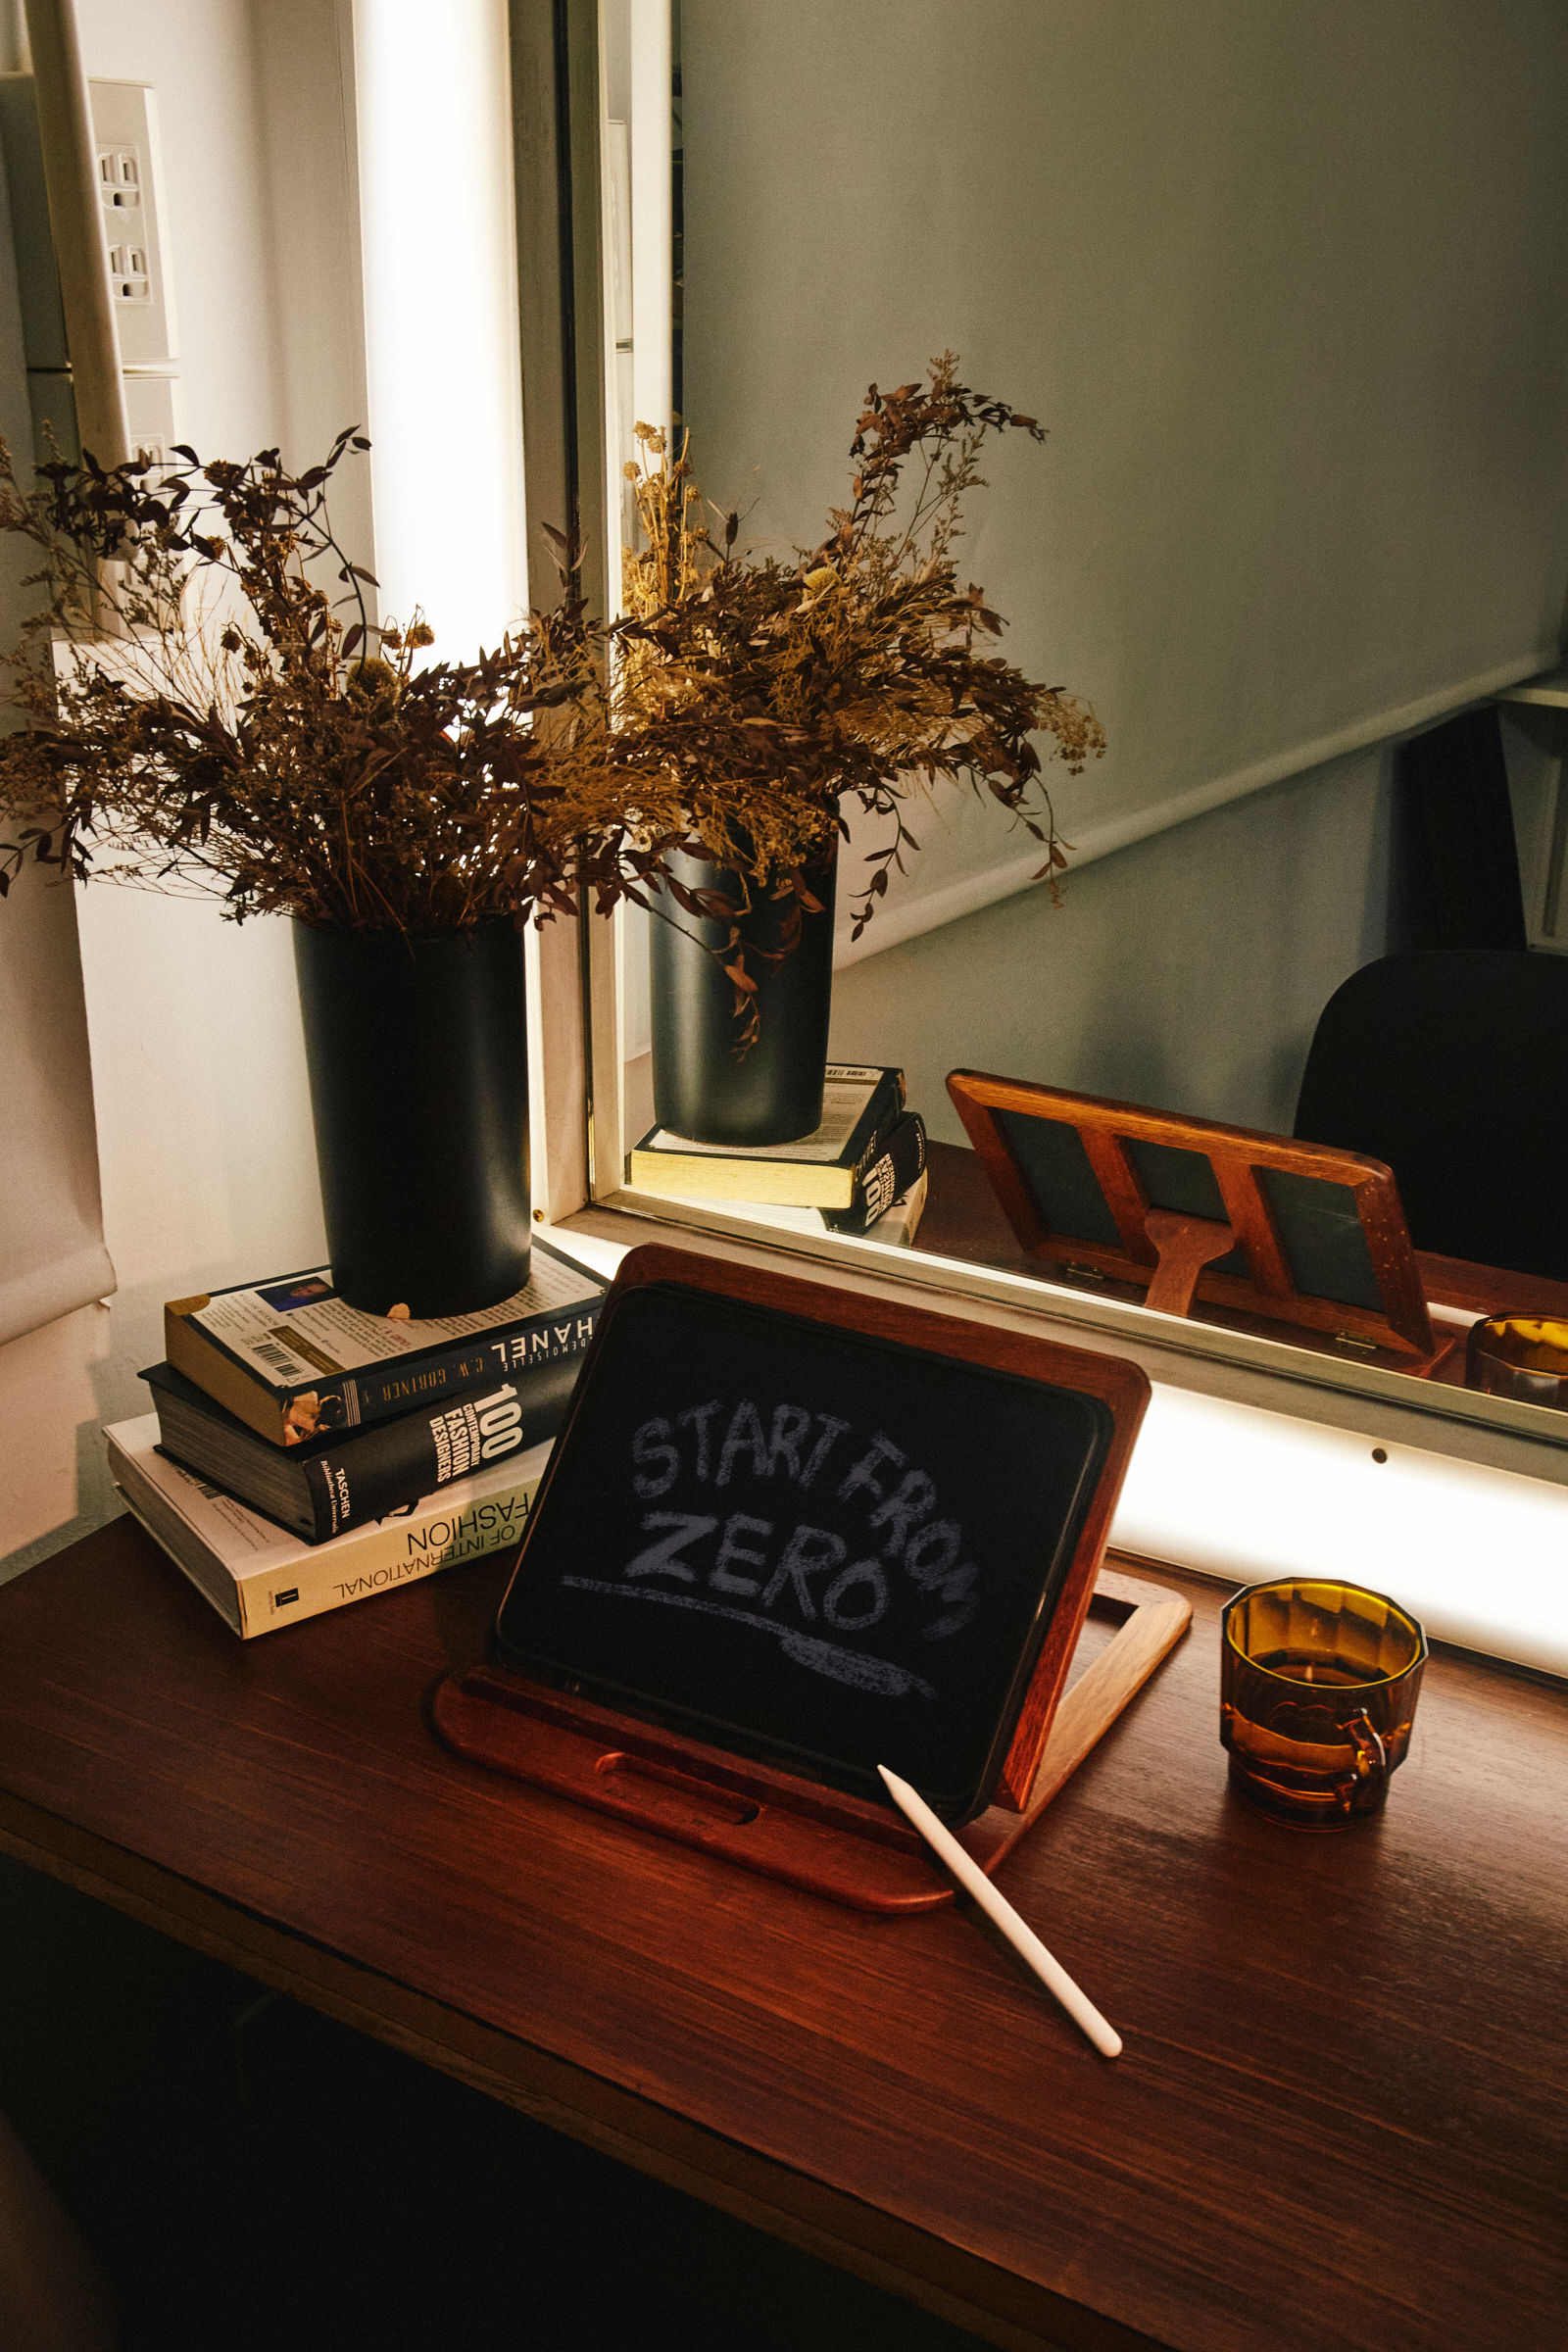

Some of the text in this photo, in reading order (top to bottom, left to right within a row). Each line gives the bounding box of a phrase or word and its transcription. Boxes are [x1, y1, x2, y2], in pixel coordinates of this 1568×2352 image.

[491, 1316, 593, 1363] HANEL
[503, 1335, 593, 1371] DEMOISELLE
[382, 1368, 447, 1401] GORTNER
[429, 1415, 452, 1483] DESIGNERS
[444, 1407, 471, 1477] FASHION
[463, 1402, 481, 1467] CONTEMPORARY
[473, 1383, 523, 1459] 100
[334, 1467, 351, 1519] TASCHEN
[406, 1492, 530, 1556] FASHION
[631, 1398, 980, 1642] START FROM
[332, 1524, 515, 1599] OF INTERNATIONAL
[623, 1510, 890, 1631] ZERO
